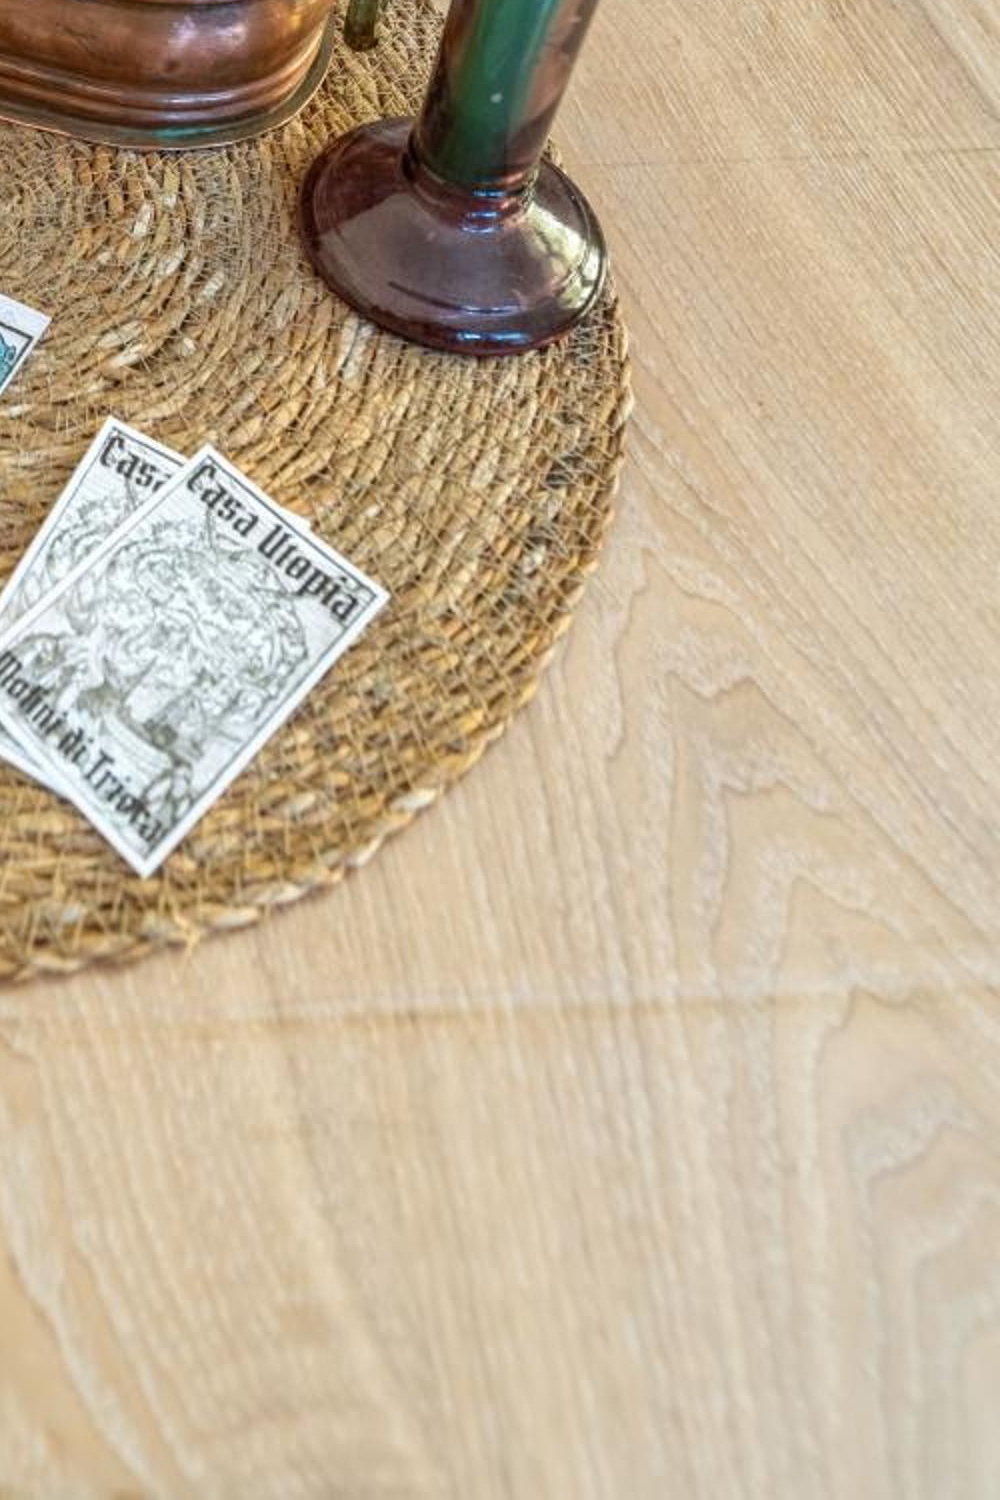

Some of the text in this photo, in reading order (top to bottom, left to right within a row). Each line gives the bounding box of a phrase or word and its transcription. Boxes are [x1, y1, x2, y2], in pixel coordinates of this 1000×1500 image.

[187, 463, 360, 623] Casa Utopia
[57, 727, 95, 763] di
